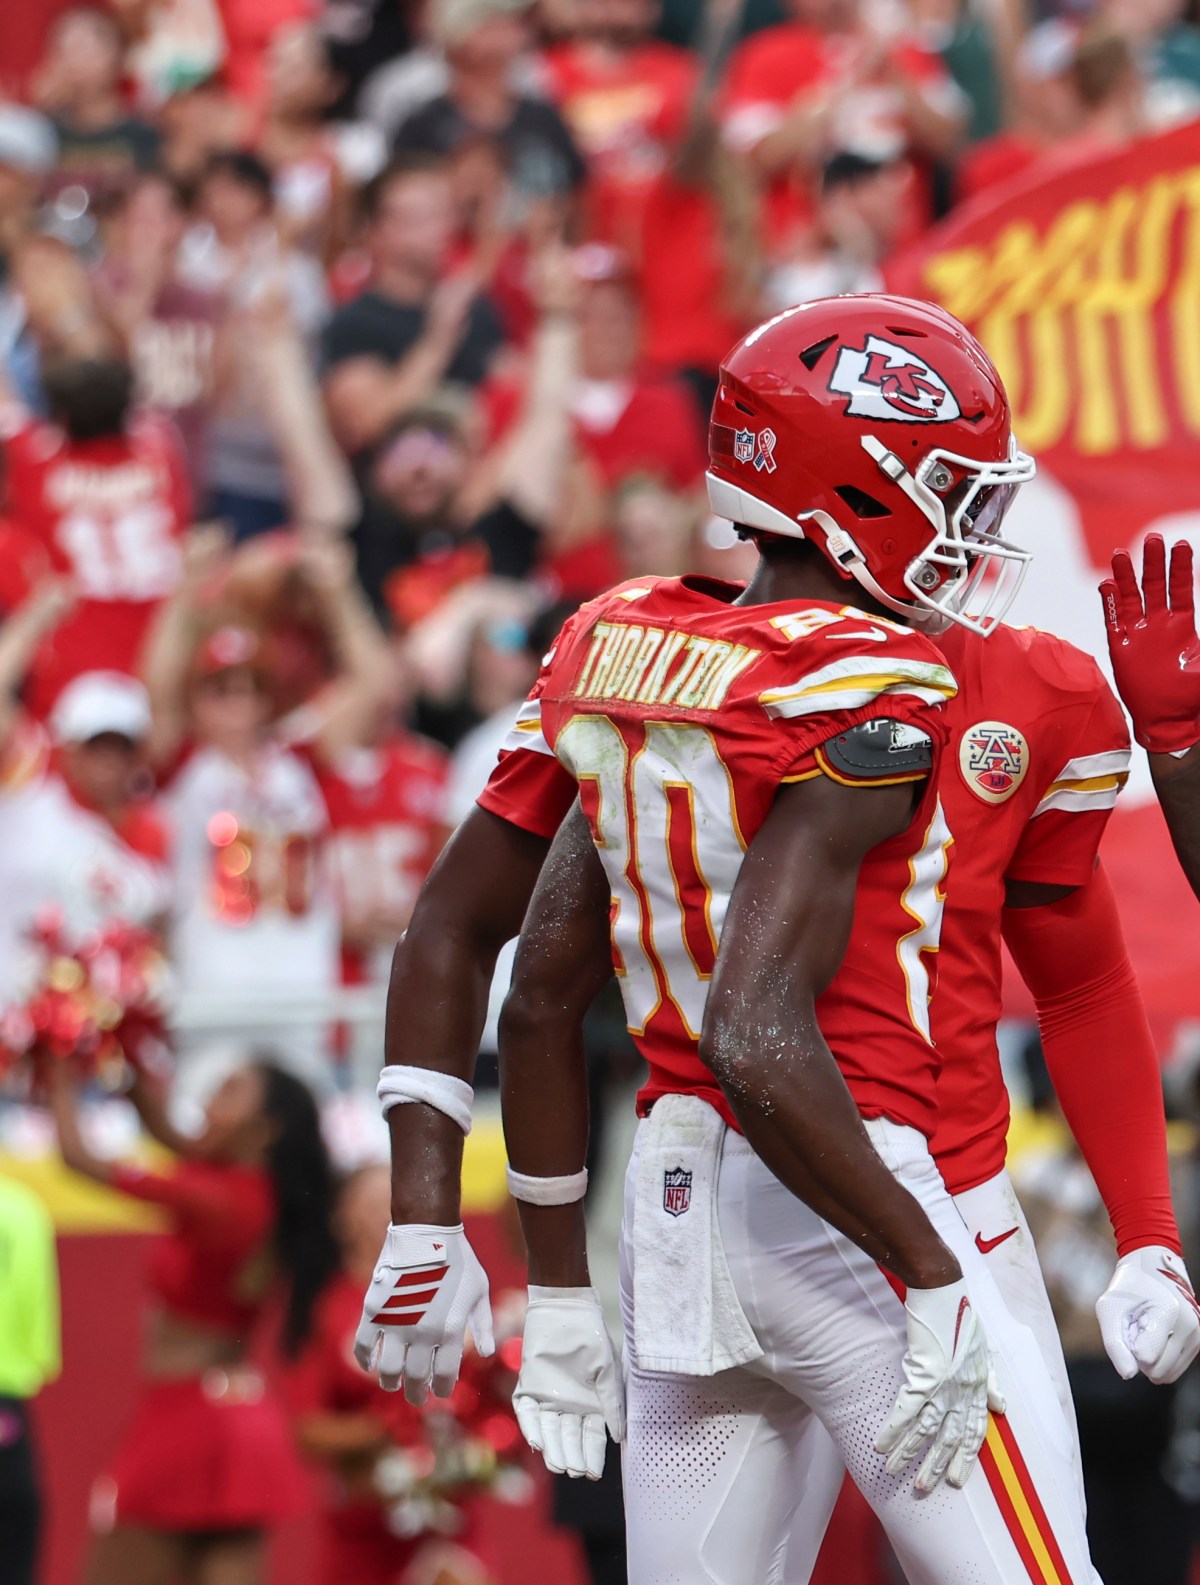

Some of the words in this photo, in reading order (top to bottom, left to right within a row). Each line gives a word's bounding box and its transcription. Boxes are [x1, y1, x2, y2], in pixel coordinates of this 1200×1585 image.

[859, 351, 946, 418] KC
[574, 621, 762, 710] THORNTON
[665, 1187, 689, 1212] NFL
